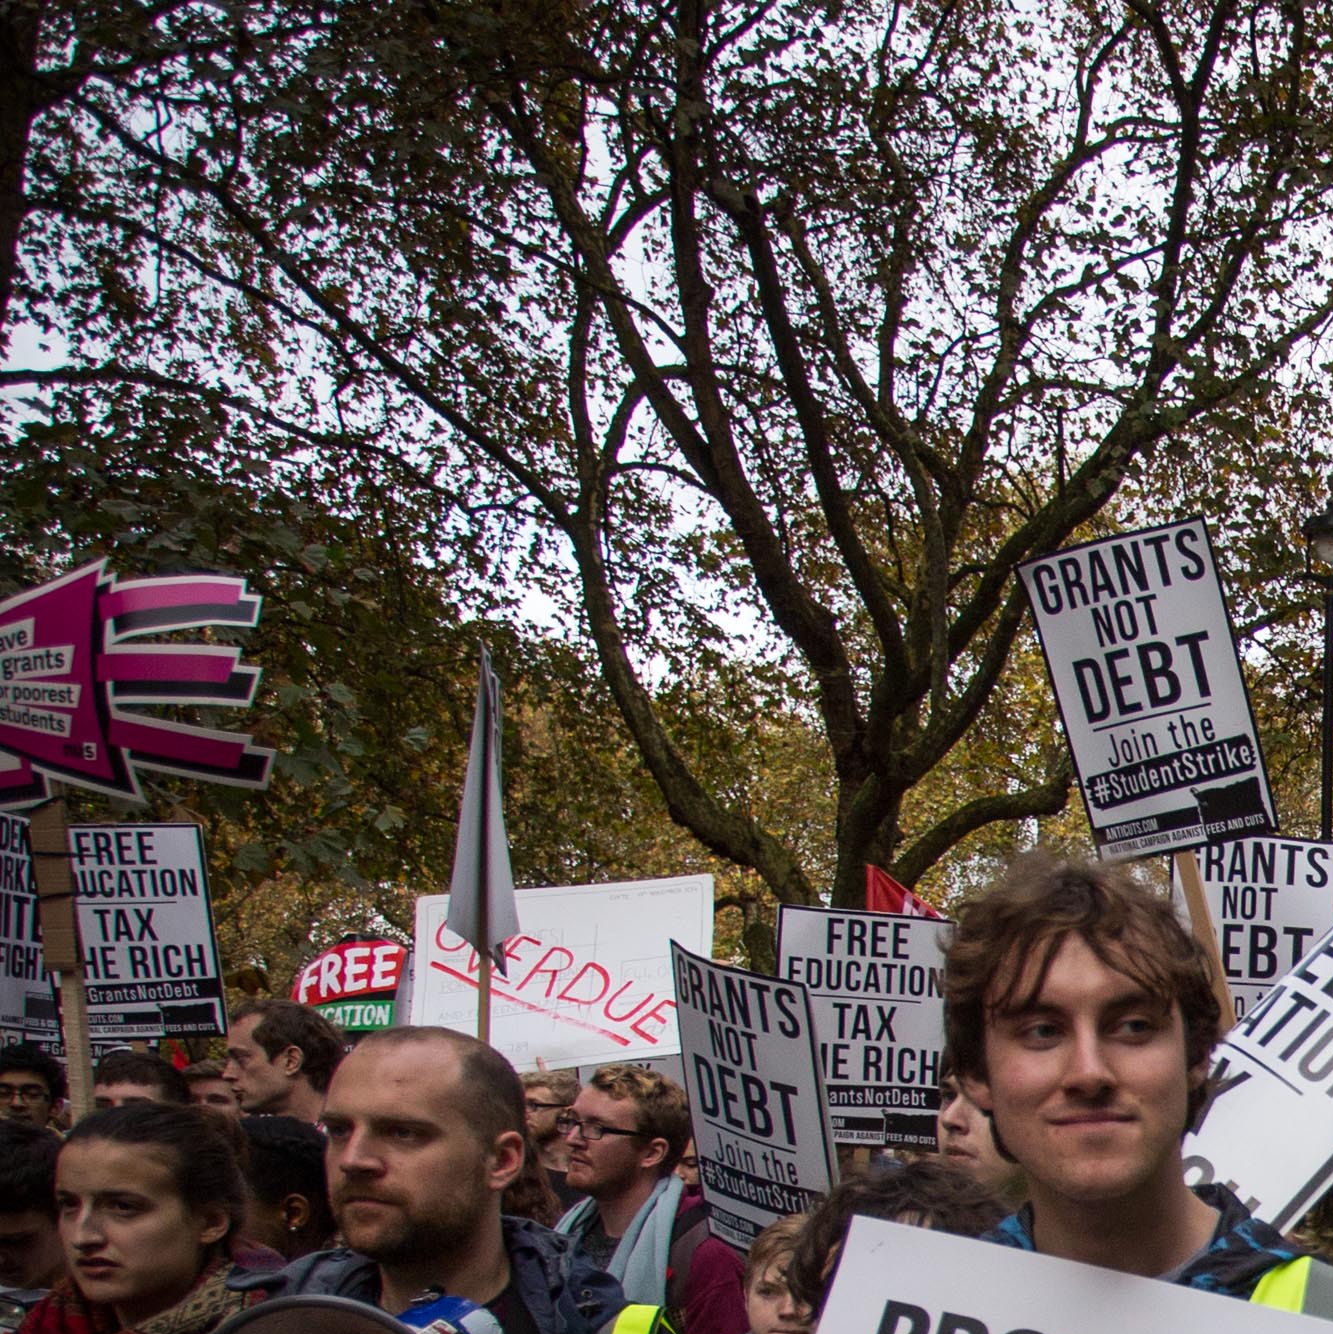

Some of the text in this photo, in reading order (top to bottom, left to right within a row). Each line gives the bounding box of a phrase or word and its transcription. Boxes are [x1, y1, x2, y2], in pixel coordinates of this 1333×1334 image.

[1033, 528, 1205, 615] GRANTS
[1090, 594, 1157, 648] NOT
[2, 651, 65, 680] grants
[1072, 630, 1211, 723] DEBT
[12, 685, 75, 703] poorest
[0, 706, 66, 732] students
[1108, 714, 1216, 768] Join the
[1094, 742, 1251, 804] #StudentStrike
[75, 831, 158, 866] FREE
[1106, 818, 1158, 841] ANTICUTS.COM
[1139, 834, 1171, 849] CAMPAIGN
[1206, 822, 1226, 835] FEES
[1228, 816, 1244, 830] AND
[1245, 813, 1265, 826] CUTS
[76, 868, 199, 898] UCATION
[1200, 841, 1329, 888] RANTS
[1222, 886, 1278, 920] NOT
[93, 907, 159, 943] TAX
[826, 917, 911, 960] FREE
[84, 943, 209, 980] HE RICH
[1222, 924, 1314, 979] EBT
[87, 981, 200, 1003] GrantsNotDebt
[298, 945, 400, 1004] FREE
[320, 1004, 391, 1026] CATION
[678, 953, 800, 1039] GRANTS
[87, 1013, 125, 1025] CUTS.COM
[833, 1003, 897, 1042] TAX
[709, 1019, 758, 1071] NOT
[863, 1045, 939, 1087] RICH
[693, 1053, 798, 1146] DEBT
[829, 1088, 926, 1106] antsNotDebt
[715, 1132, 798, 1185] Join the
[904, 1134, 918, 1144] AND
[919, 1136, 936, 1146] CUTS
